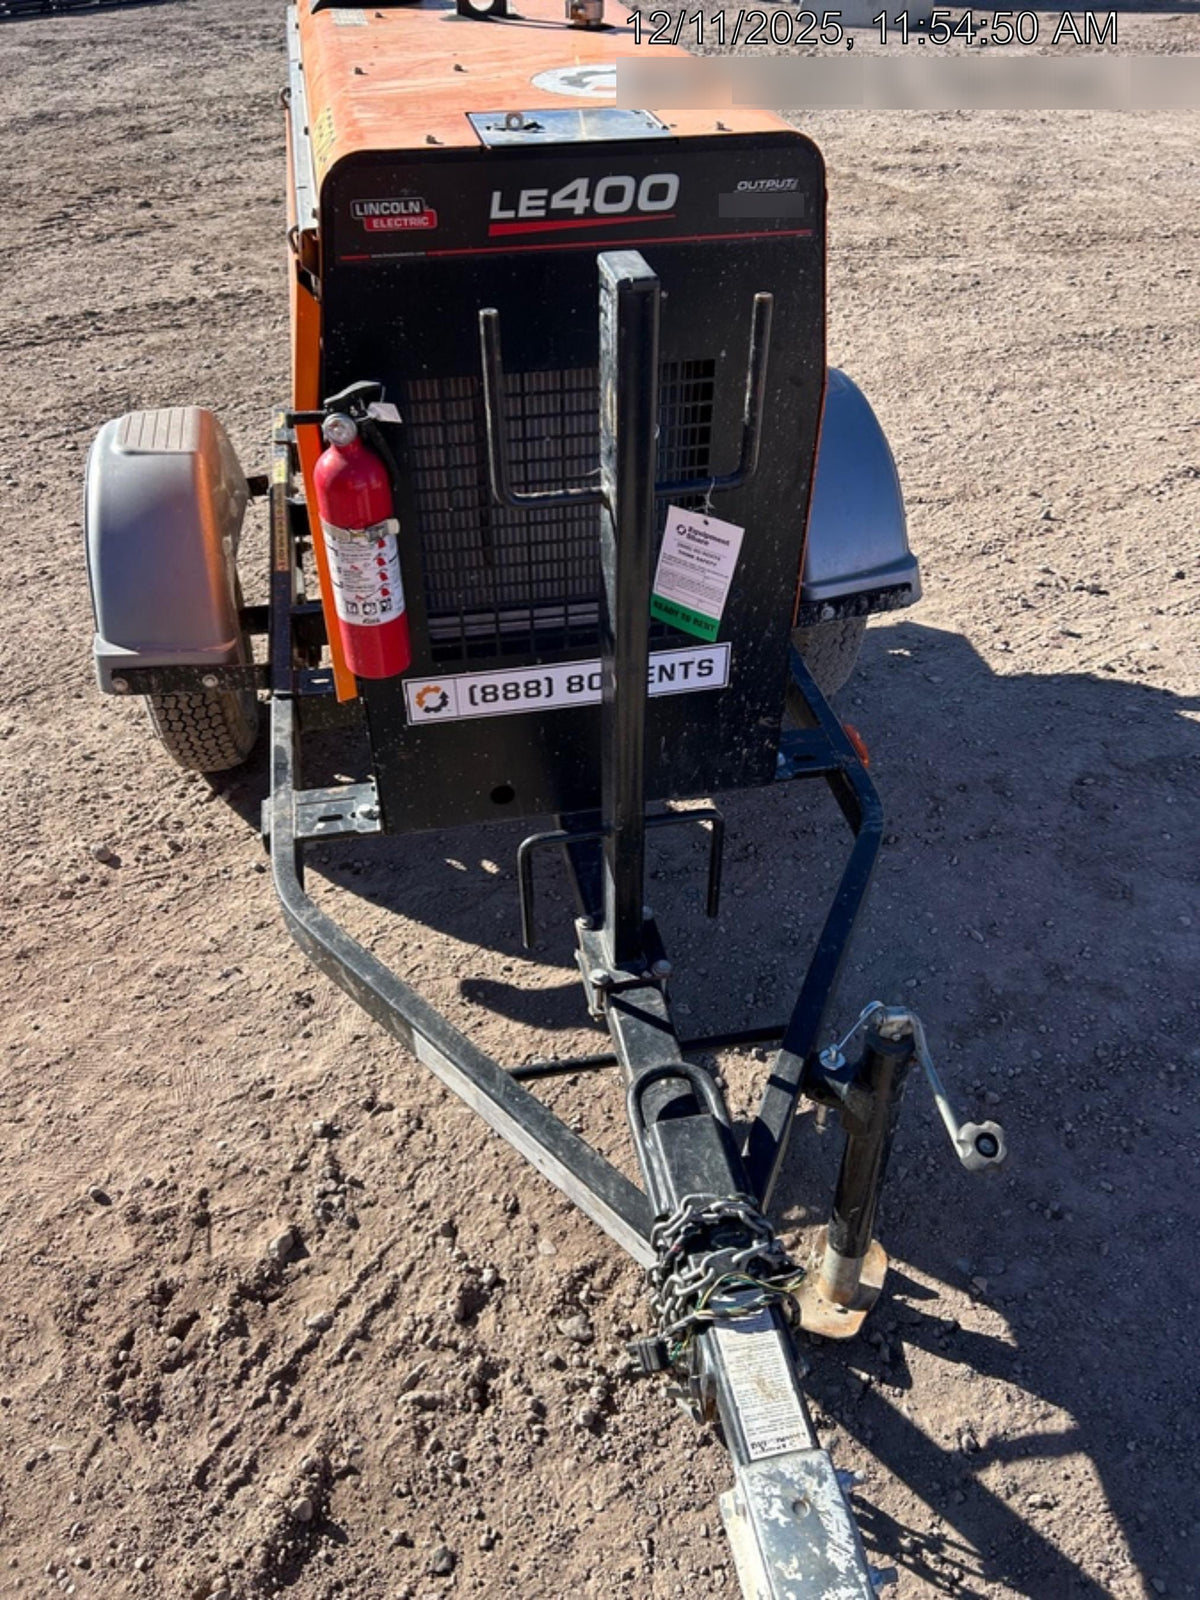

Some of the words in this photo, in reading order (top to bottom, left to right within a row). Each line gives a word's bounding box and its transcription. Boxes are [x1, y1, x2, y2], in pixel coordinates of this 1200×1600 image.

[489, 173, 680, 220] LE400
[355, 201, 421, 216] LINCOLN
[372, 216, 430, 229] ELECTRIC
[681, 609, 692, 623] TO
[693, 617, 716, 632] RENT
[469, 676, 554, 706] (888)
